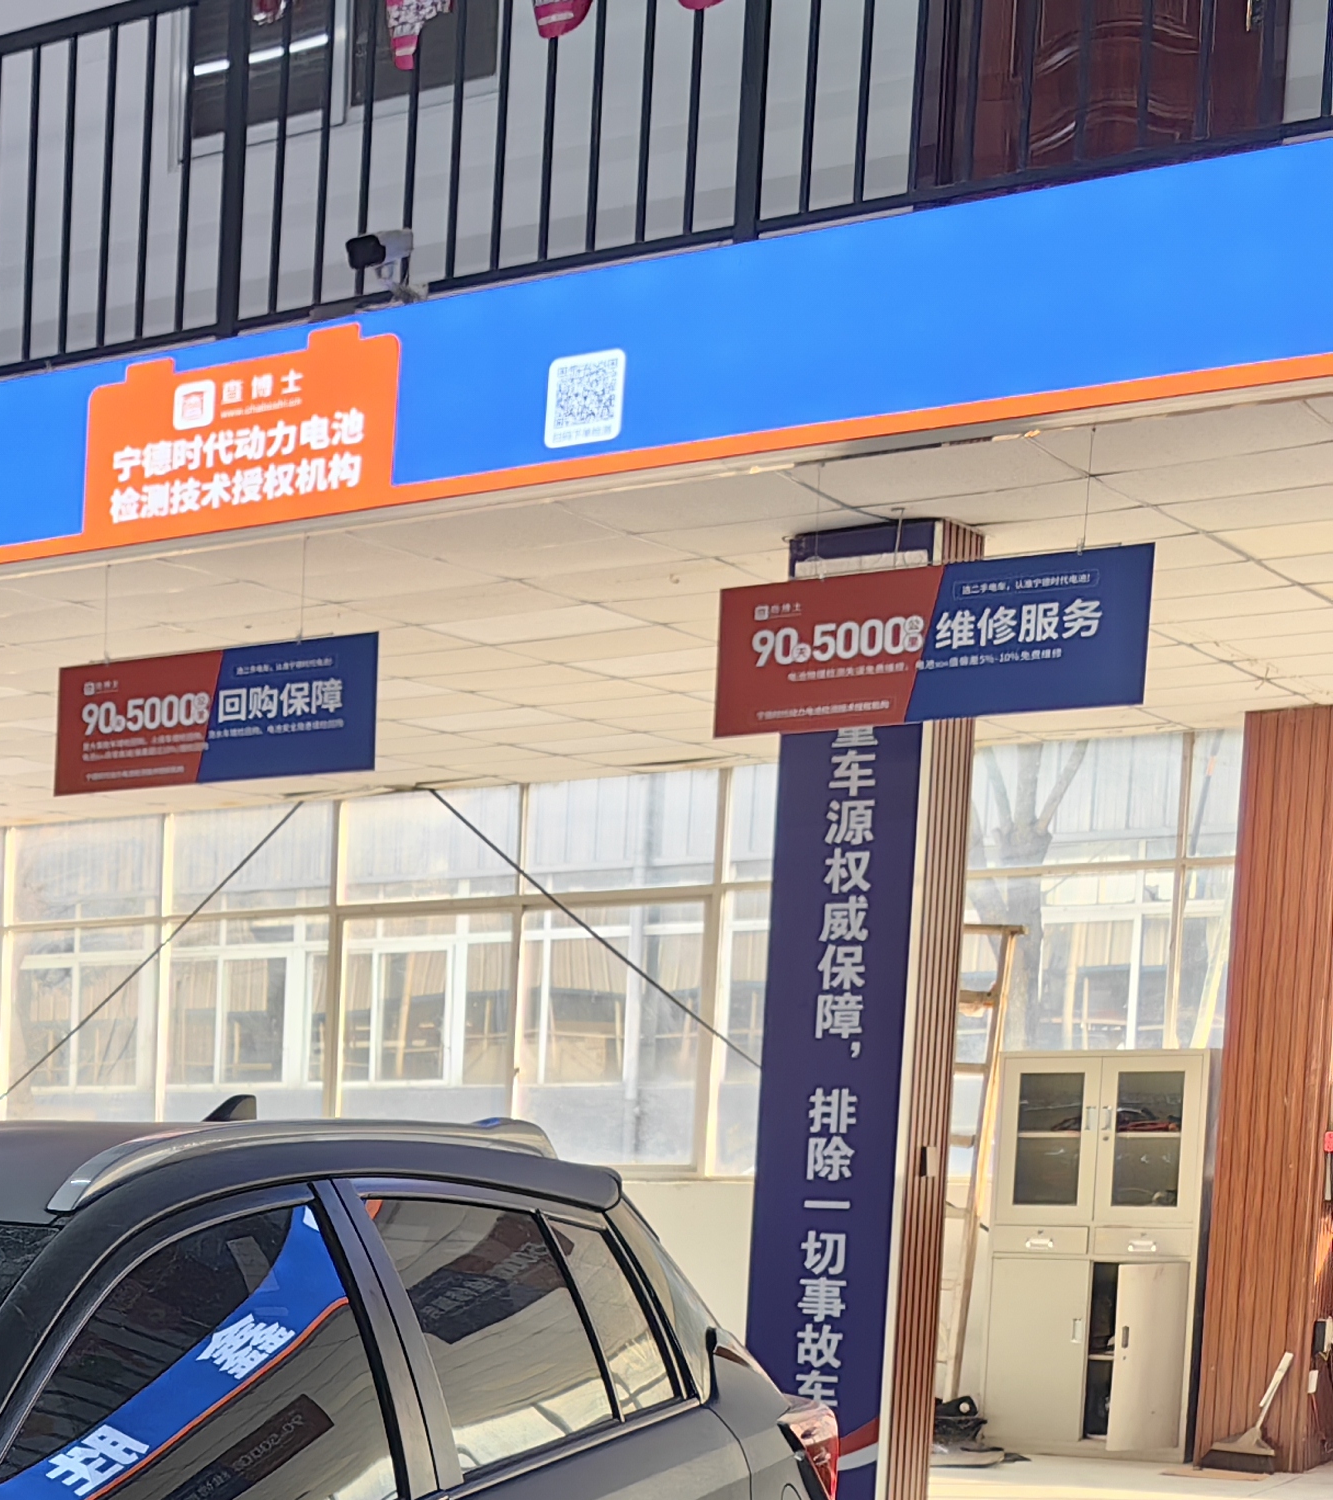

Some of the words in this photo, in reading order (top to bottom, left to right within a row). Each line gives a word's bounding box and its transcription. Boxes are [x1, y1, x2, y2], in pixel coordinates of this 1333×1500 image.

[112, 407, 365, 483] 宁德时代动力电池
[109, 451, 363, 524] 检测技术授权机构
[935, 597, 1104, 651] 维修服务
[217, 678, 344, 723] 回购保障
